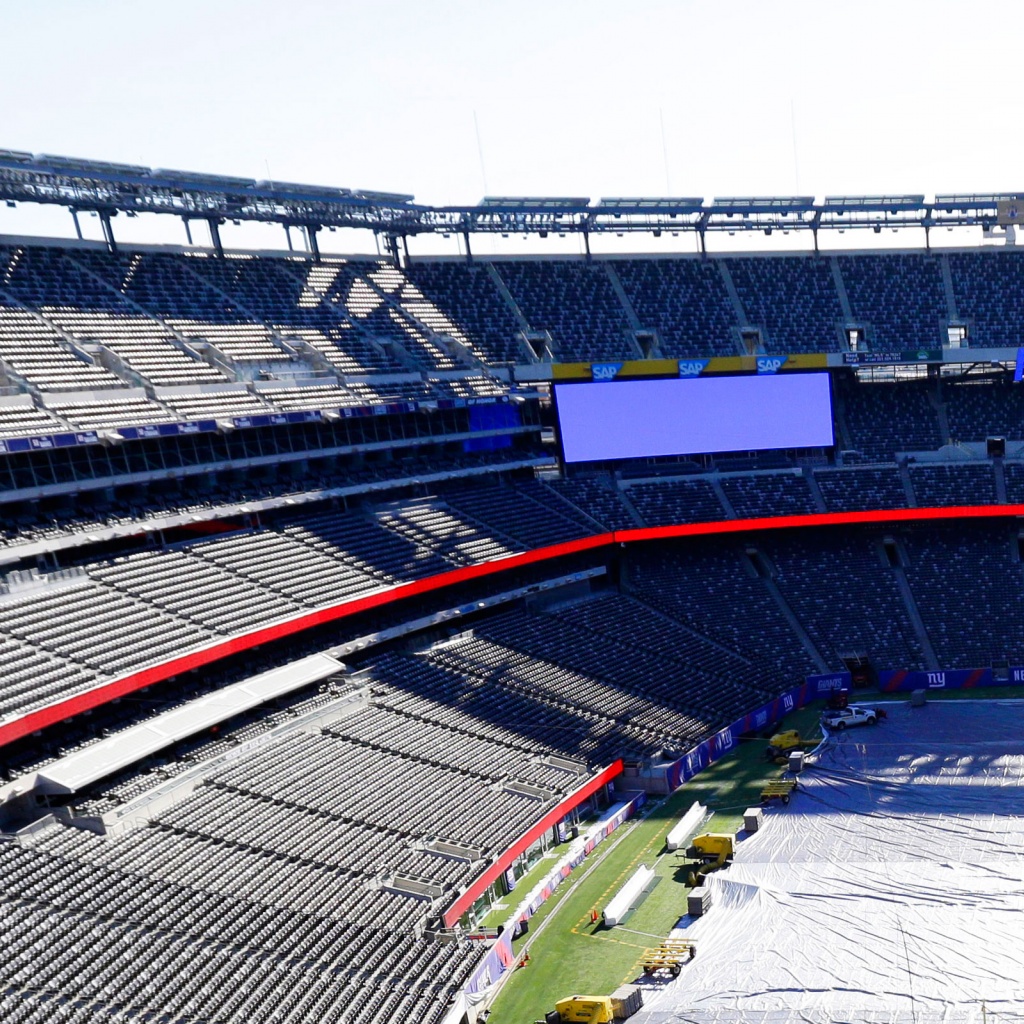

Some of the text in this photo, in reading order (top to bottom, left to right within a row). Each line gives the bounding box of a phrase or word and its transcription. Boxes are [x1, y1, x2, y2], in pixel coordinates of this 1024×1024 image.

[679, 363, 703, 376] SAP
[757, 359, 781, 372] SAP
[592, 366, 617, 380] SAP
[817, 678, 842, 690] GIANTS
[927, 672, 946, 688] ny
